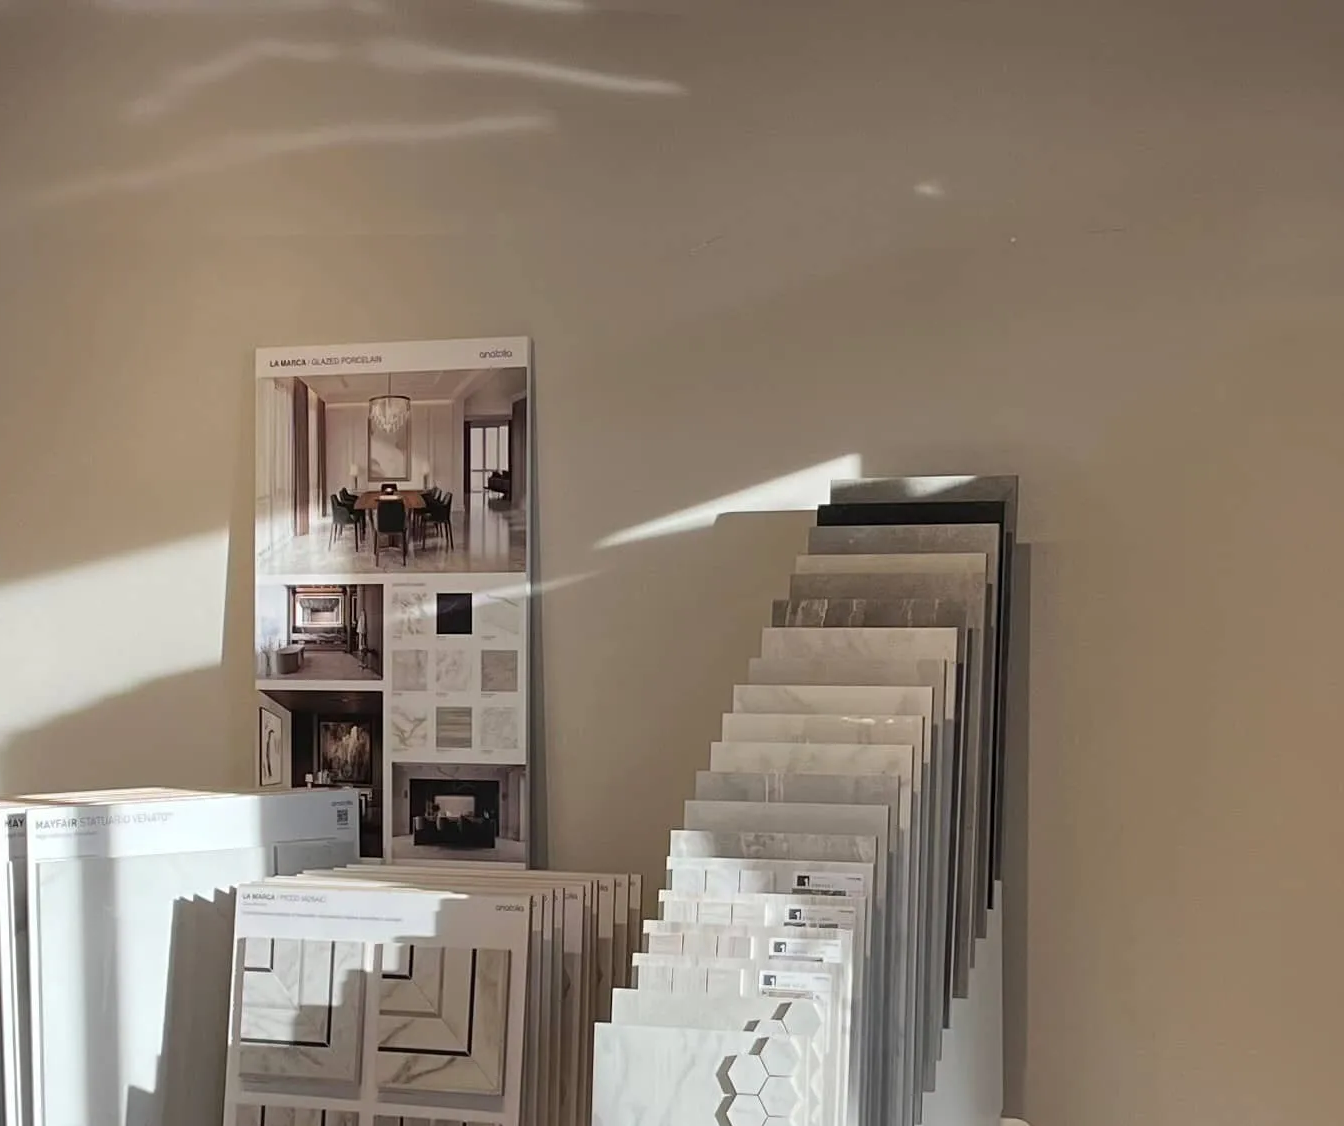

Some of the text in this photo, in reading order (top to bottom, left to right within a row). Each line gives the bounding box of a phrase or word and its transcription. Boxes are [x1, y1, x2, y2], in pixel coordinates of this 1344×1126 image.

[269, 360, 280, 368] LA
[280, 358, 306, 368] MARCA
[35, 817, 78, 830] MAYFAIR
[78, 814, 131, 828] STATUARIO
